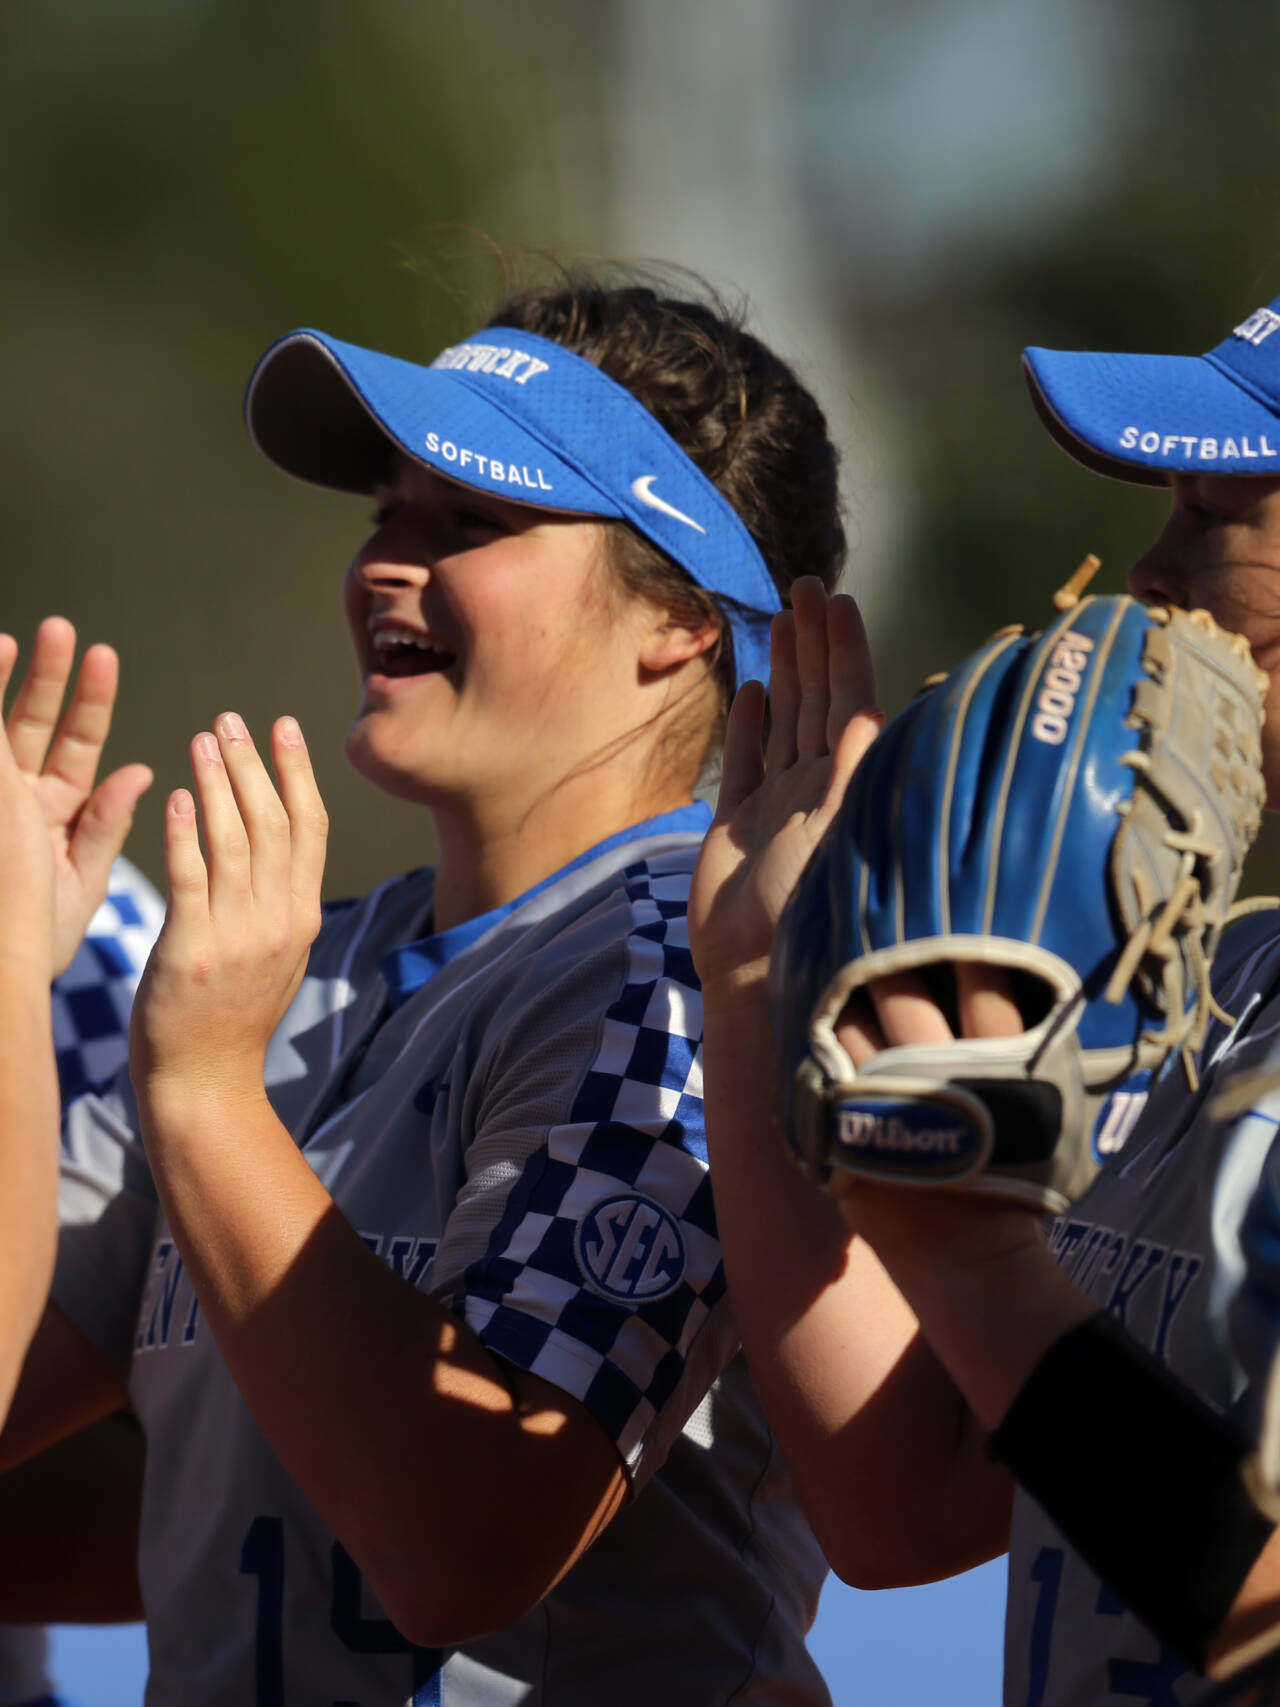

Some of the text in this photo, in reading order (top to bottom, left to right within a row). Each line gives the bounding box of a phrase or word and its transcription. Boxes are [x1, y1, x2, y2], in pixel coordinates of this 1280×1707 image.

[425, 432, 553, 491] SOFTBALL
[1119, 425, 1278, 460] SOFTBALL
[1032, 630, 1095, 745] A2000
[838, 1110, 960, 1153] Wilson
[585, 1199, 680, 1296] SEC
